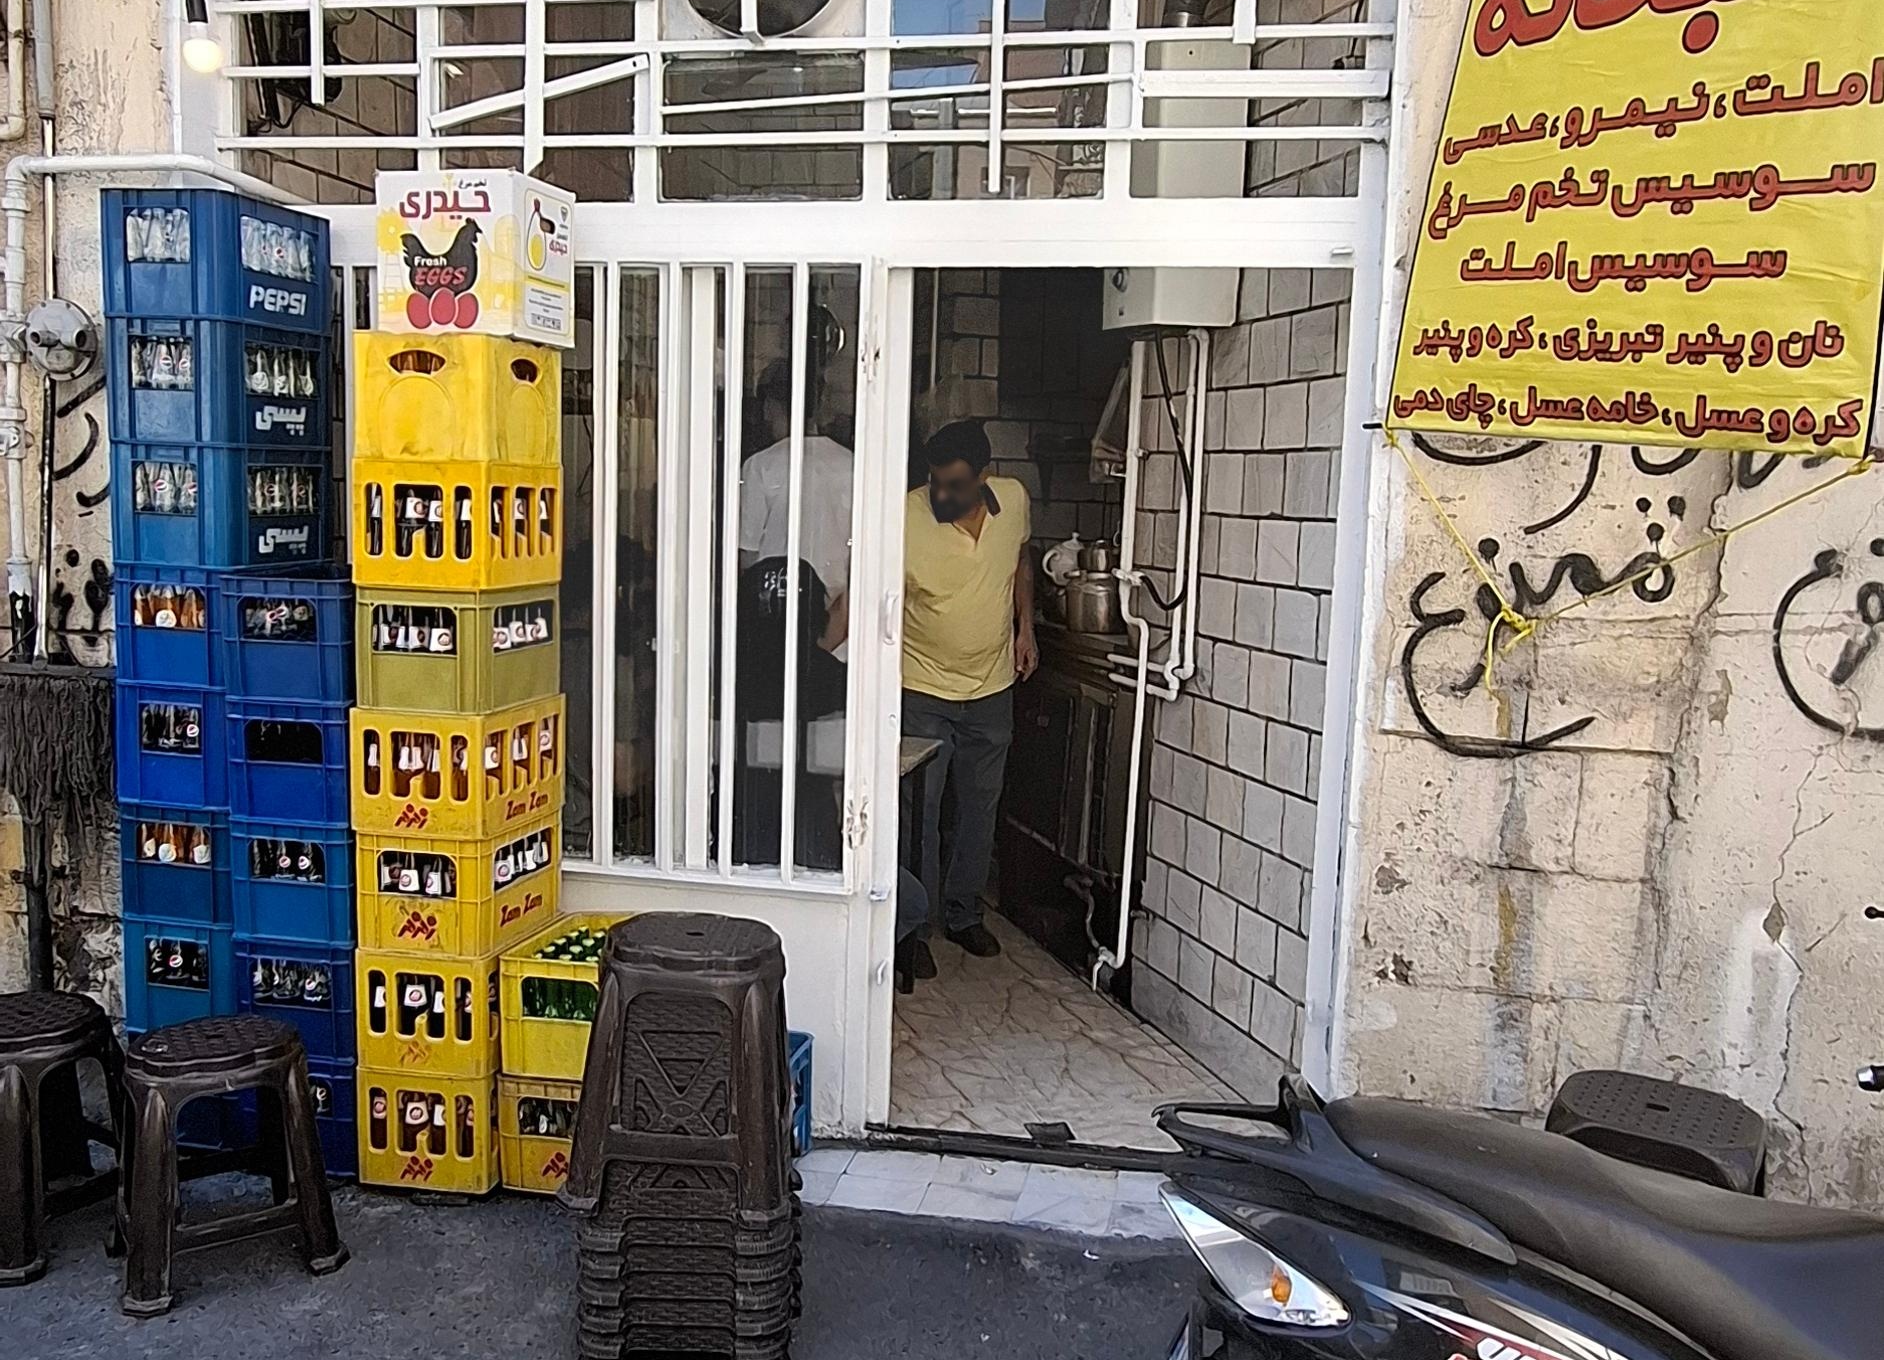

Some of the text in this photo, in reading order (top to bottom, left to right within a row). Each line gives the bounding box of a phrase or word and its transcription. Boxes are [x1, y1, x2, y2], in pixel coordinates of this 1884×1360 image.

[1443, 112, 1548, 165] عدسی
[399, 190, 492, 220] حیدری
[1428, 162, 1877, 240] سوسیس تخم مرغ
[414, 256, 447, 266] Fresh
[415, 266, 470, 285] EGGS
[1460, 242, 1788, 293] سوسیس املت
[249, 284, 307, 316] PEPSI
[1413, 320, 1466, 362] پنیر
[1467, 325, 1481, 358] و
[1487, 316, 1534, 359] کره
[1667, 323, 1744, 373] پنیر
[1749, 330, 1773, 367] و
[1778, 320, 1845, 367] نان
[255, 405, 307, 435] پپسی
[1394, 387, 1444, 419] دمی
[1445, 383, 1496, 429] چای
[1586, 391, 1659, 426] خامه
[1793, 399, 1863, 443] کره
[1766, 409, 1789, 444] و
[259, 524, 309, 555] پپسی
